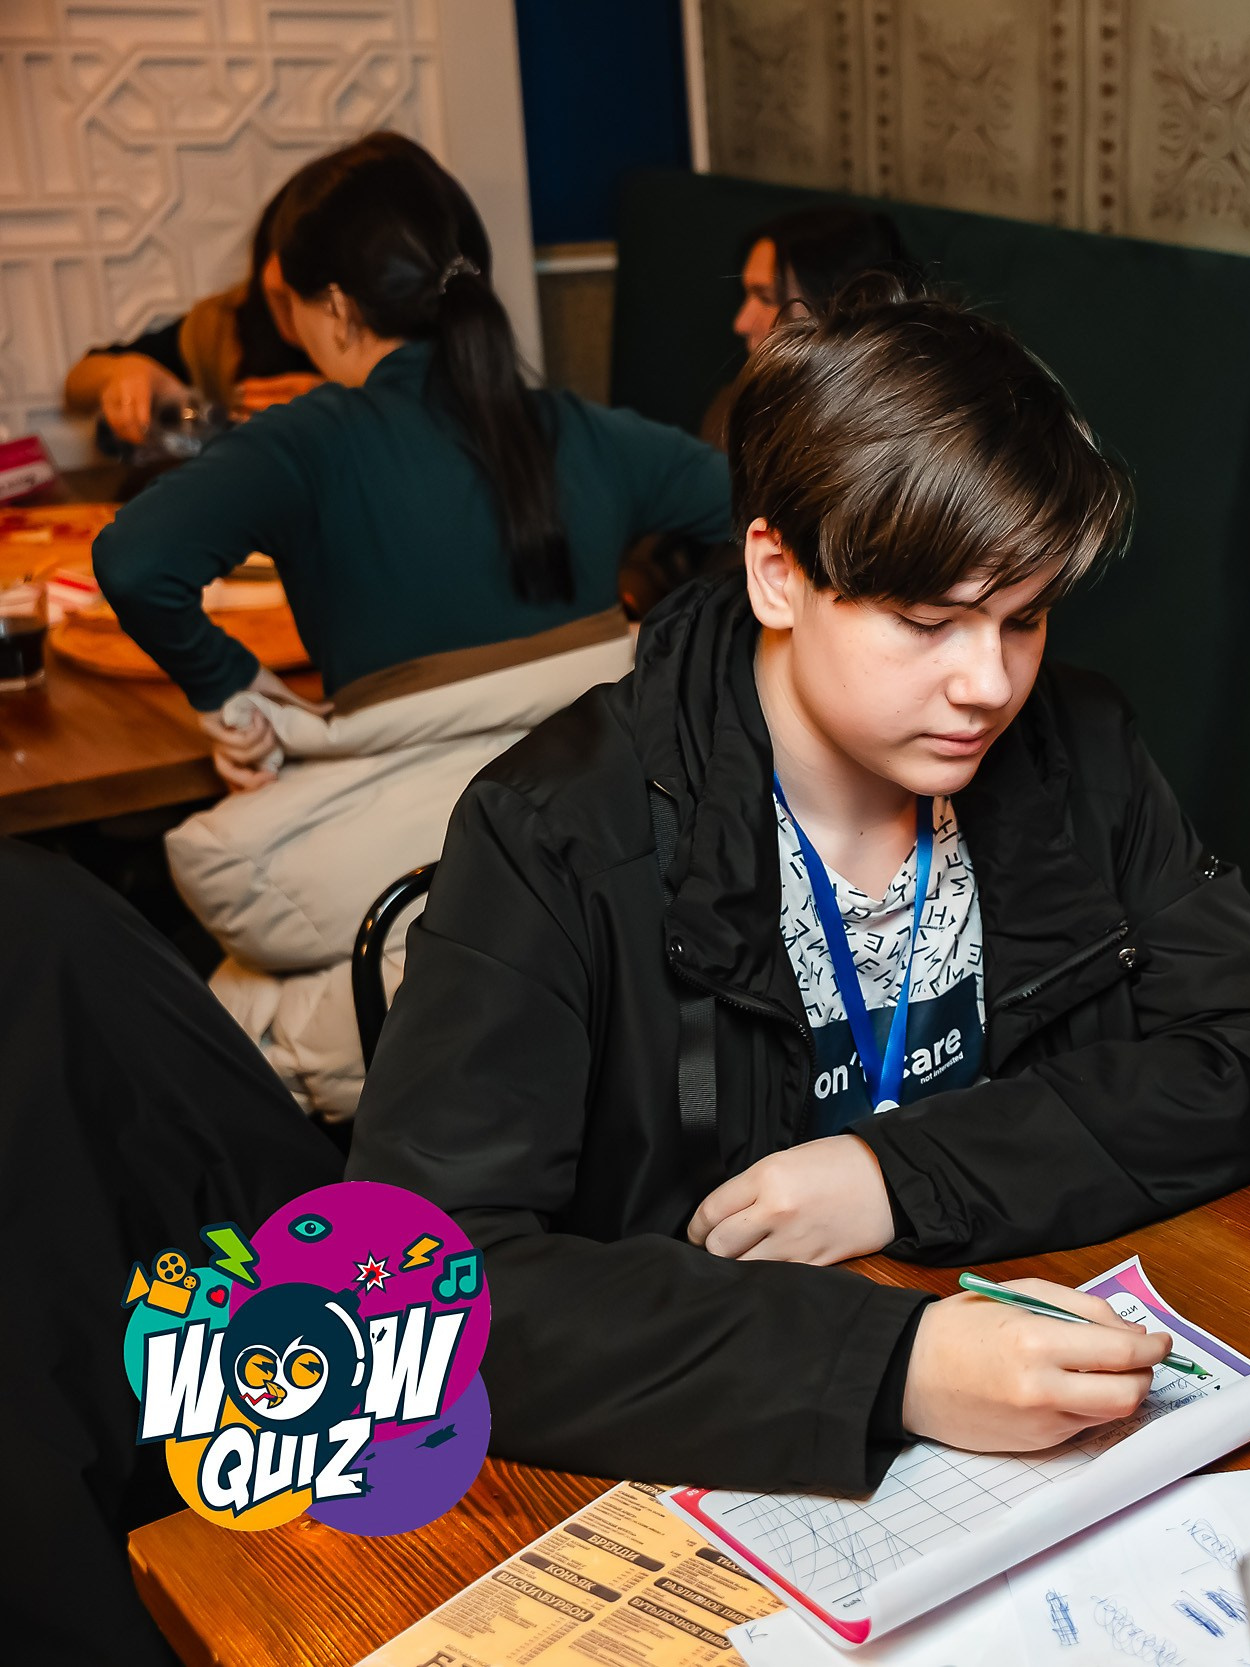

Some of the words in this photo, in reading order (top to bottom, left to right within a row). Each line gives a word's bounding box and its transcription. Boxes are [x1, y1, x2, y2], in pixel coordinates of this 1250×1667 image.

[920, 1071, 934, 1085] not
[588, 1534, 641, 1562] БРЕНДИ
[544, 1563, 597, 1592] КОНЬЯК
[662, 1580, 722, 1613] РАЗЛИВНОЕ
[631, 1598, 702, 1635] БУТЫЛОЧНОЕ
[700, 1628, 731, 1649] ПИВО
